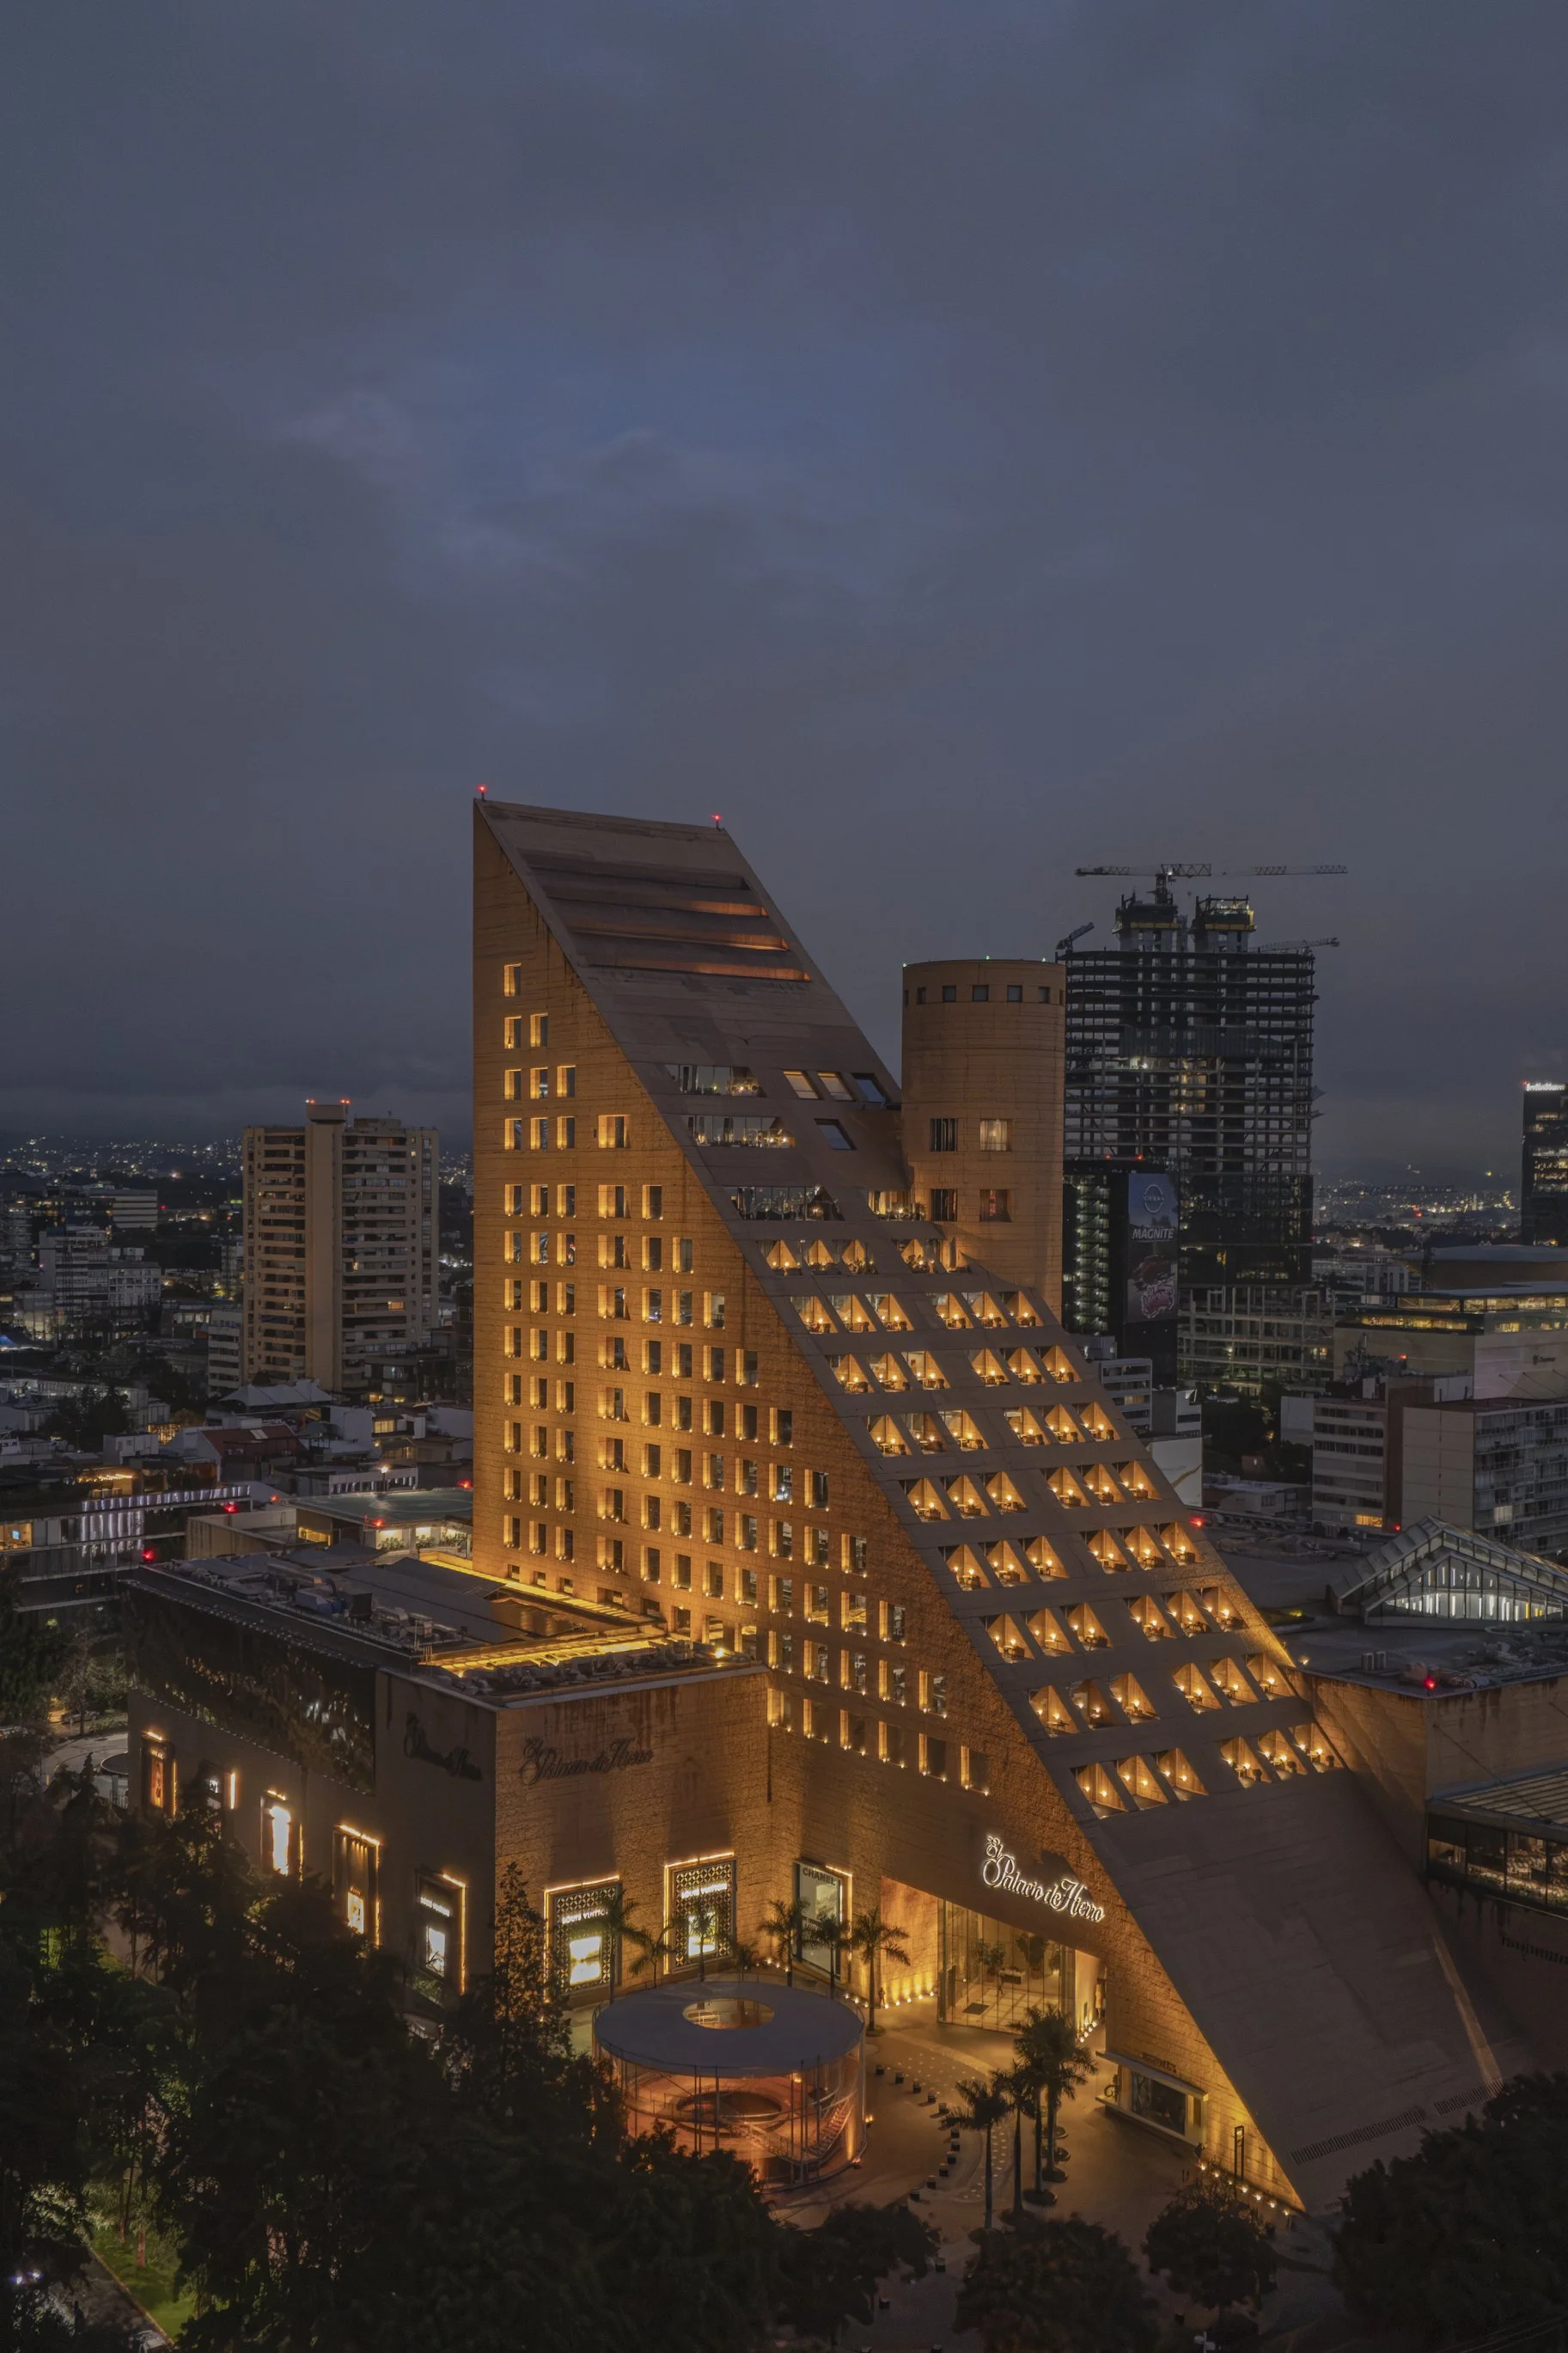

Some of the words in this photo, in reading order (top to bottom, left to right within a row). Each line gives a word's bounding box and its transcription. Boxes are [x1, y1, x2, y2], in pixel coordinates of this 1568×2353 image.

[1132, 1228, 1174, 1239] MAGNITE
[985, 1836, 1004, 1858] El
[802, 1867, 836, 1886] CHANEL
[983, 1854, 1044, 1901] Palacio
[1044, 1884, 1062, 1910] de
[1056, 1878, 1106, 1922] Hierro
